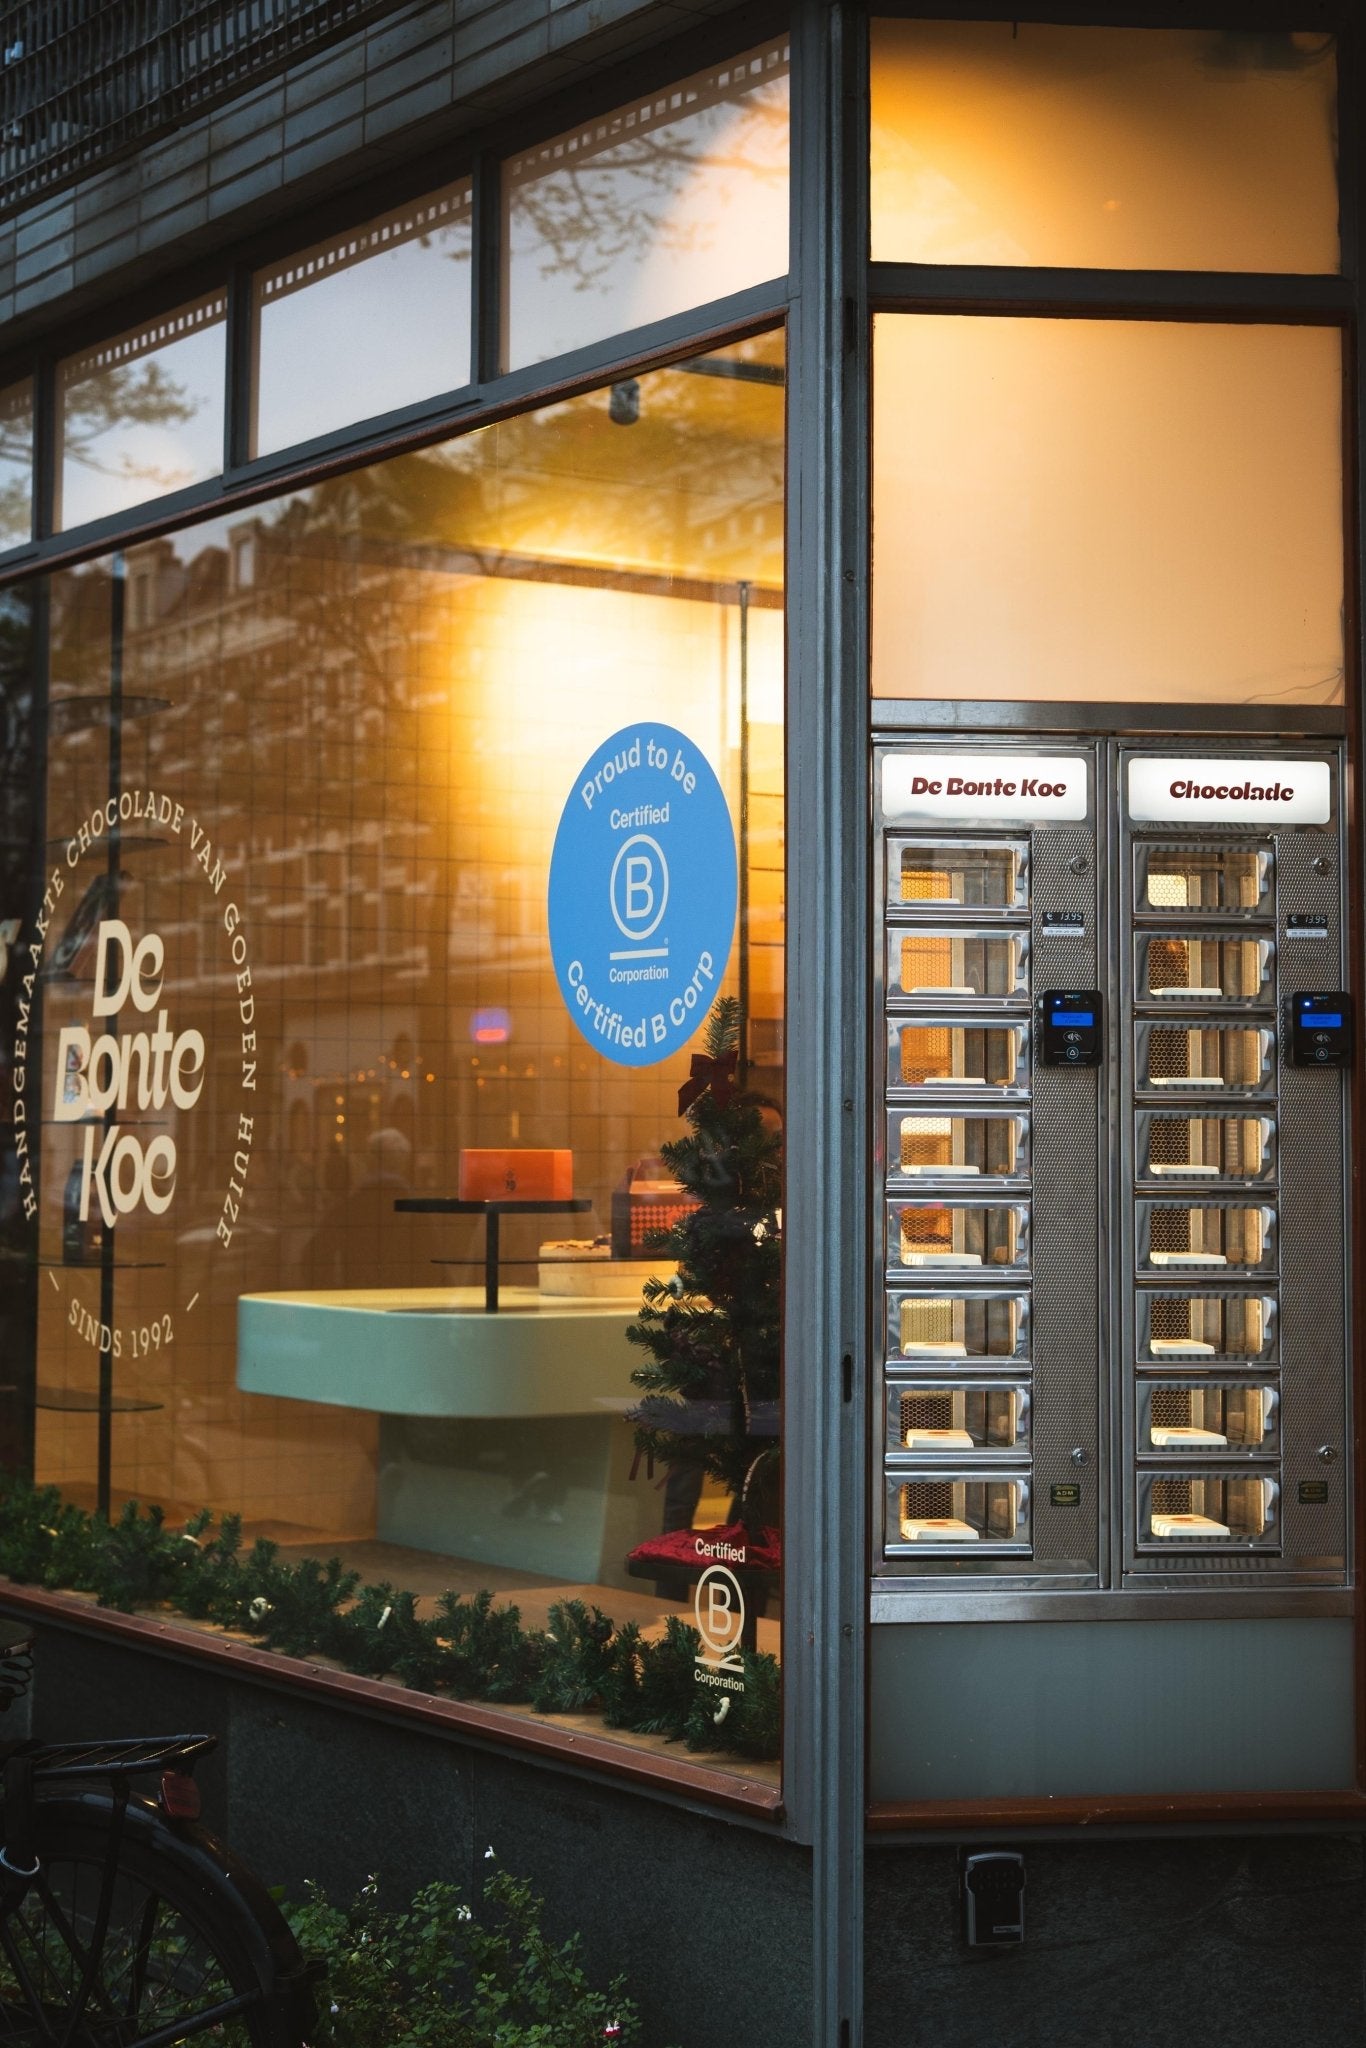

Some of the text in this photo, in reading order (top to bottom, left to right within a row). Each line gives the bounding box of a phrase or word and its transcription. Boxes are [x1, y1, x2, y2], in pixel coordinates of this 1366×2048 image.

[580, 737, 697, 811] Proud to be
[911, 776, 1067, 798] De Bonte Koe
[1169, 780, 1295, 802] Chocolade
[610, 801, 670, 830] Certified
[626, 855, 654, 919] B
[92, 919, 165, 1018] De
[609, 965, 669, 985] Corporation
[13, 790, 258, 1249] HANDGEMAAKTE CHOCOLADE VAN GOEDEN HUIZE
[567, 951, 714, 1048] Certified B Corp
[53, 1009, 206, 1121] Bonte
[79, 1125, 177, 1229] Koe
[68, 1298, 175, 1358] SINDS 1992
[695, 1537, 746, 1563] Certified
[708, 1581, 732, 1636] B
[694, 1668, 745, 1693] Corporation
